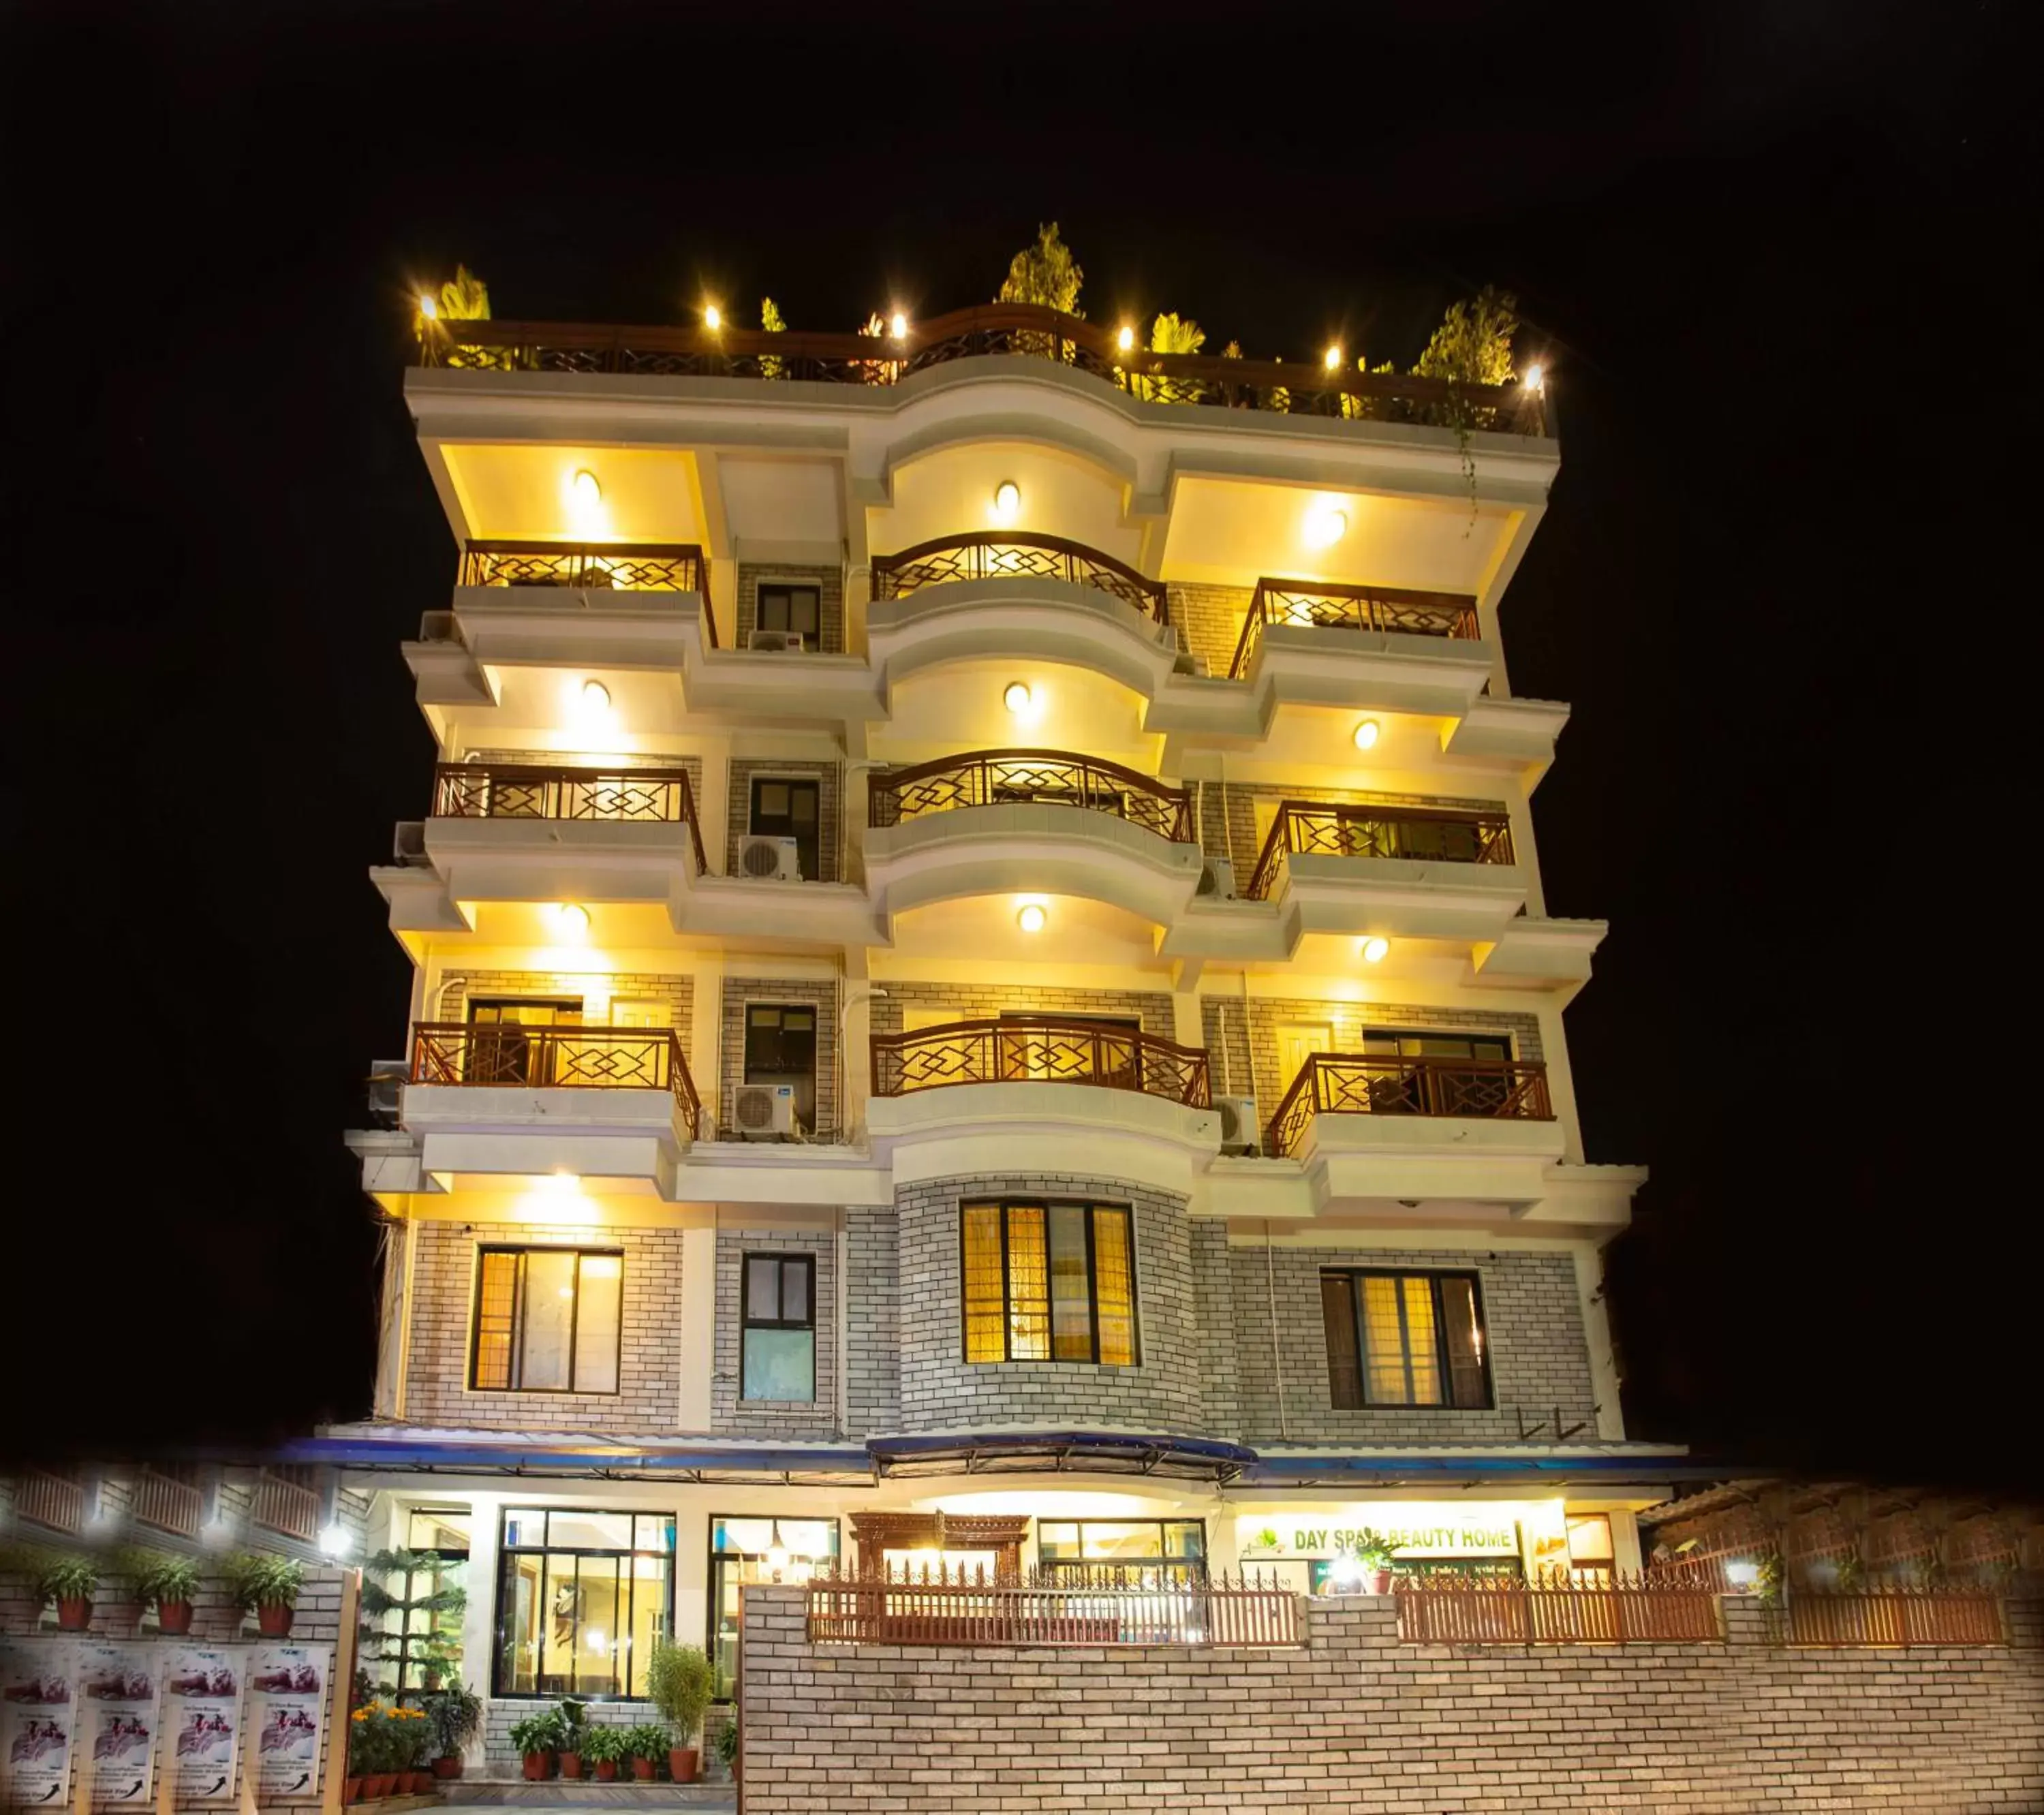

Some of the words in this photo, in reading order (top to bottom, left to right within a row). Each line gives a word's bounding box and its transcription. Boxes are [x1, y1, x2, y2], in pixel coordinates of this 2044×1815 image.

[1295, 1530, 1327, 1549] DAY
[1389, 1528, 1455, 1547] BEAUTY
[1462, 1528, 1511, 1547] HOME
